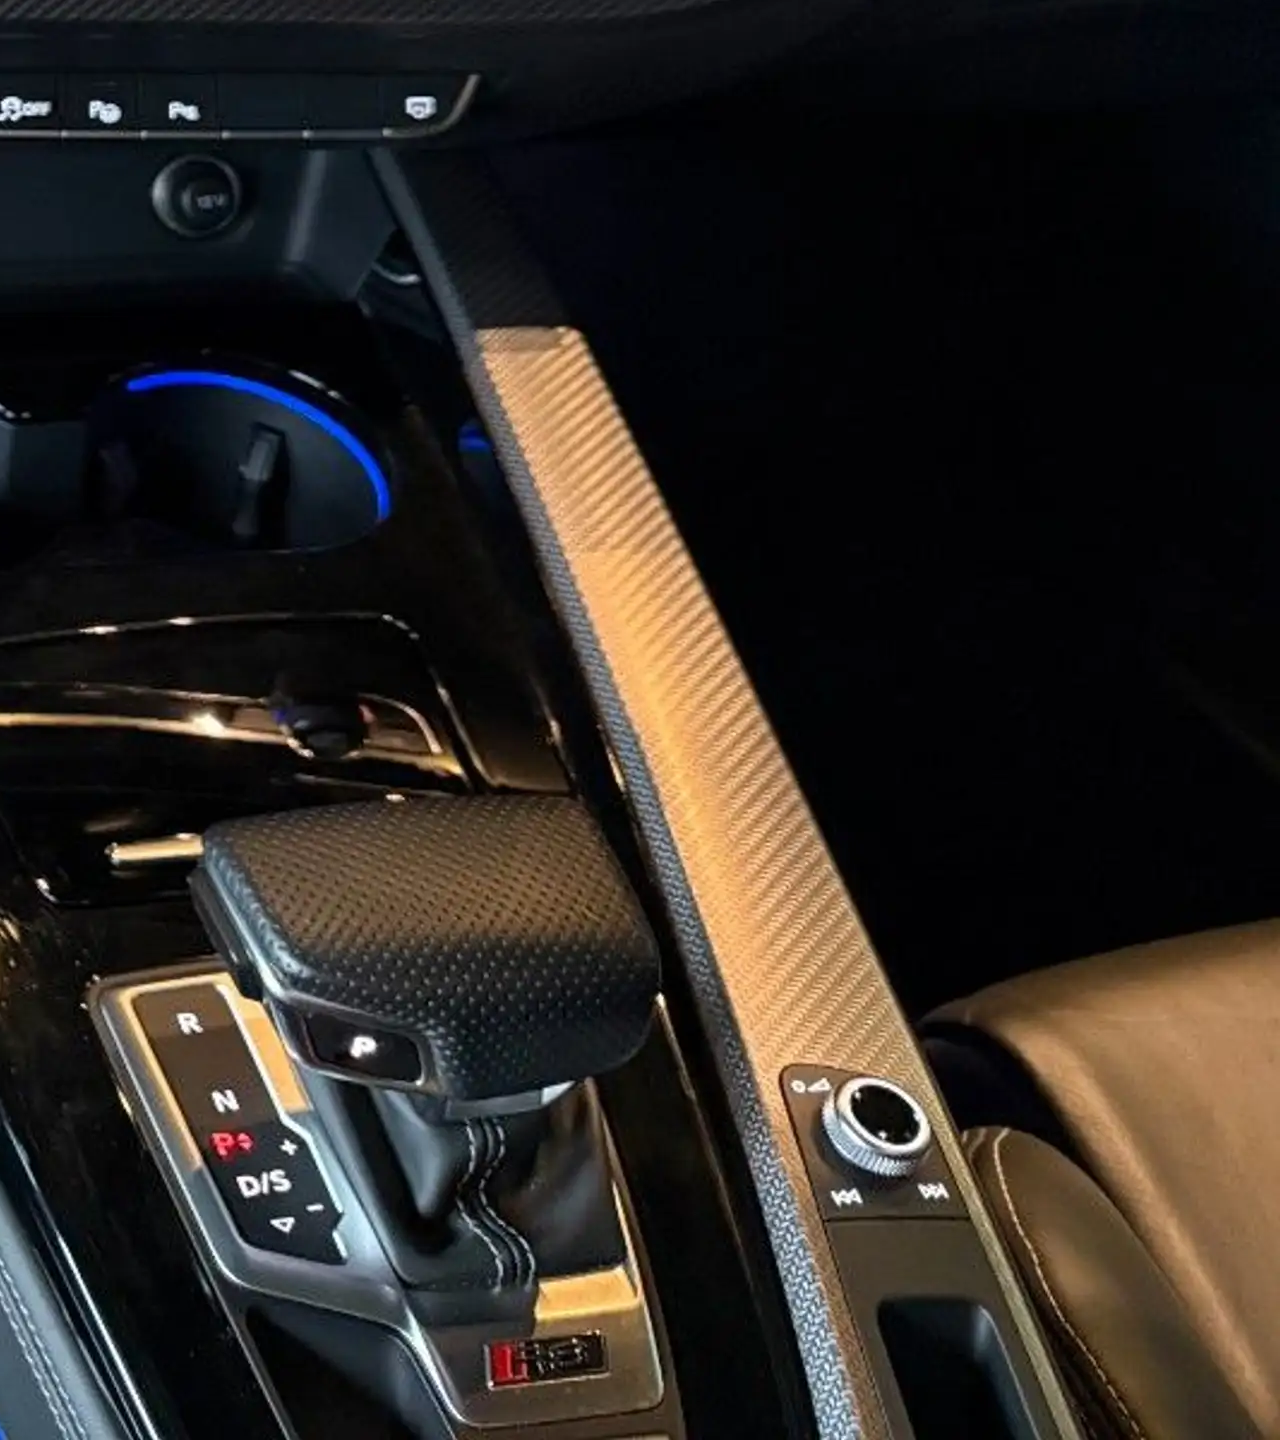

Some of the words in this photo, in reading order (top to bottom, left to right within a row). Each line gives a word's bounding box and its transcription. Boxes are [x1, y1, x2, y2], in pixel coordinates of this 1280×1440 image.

[23, 100, 53, 117] OFF
[177, 1012, 204, 1036] R
[350, 1035, 378, 1058] P
[212, 1090, 240, 1114] N
[236, 1168, 293, 1198] D/S
